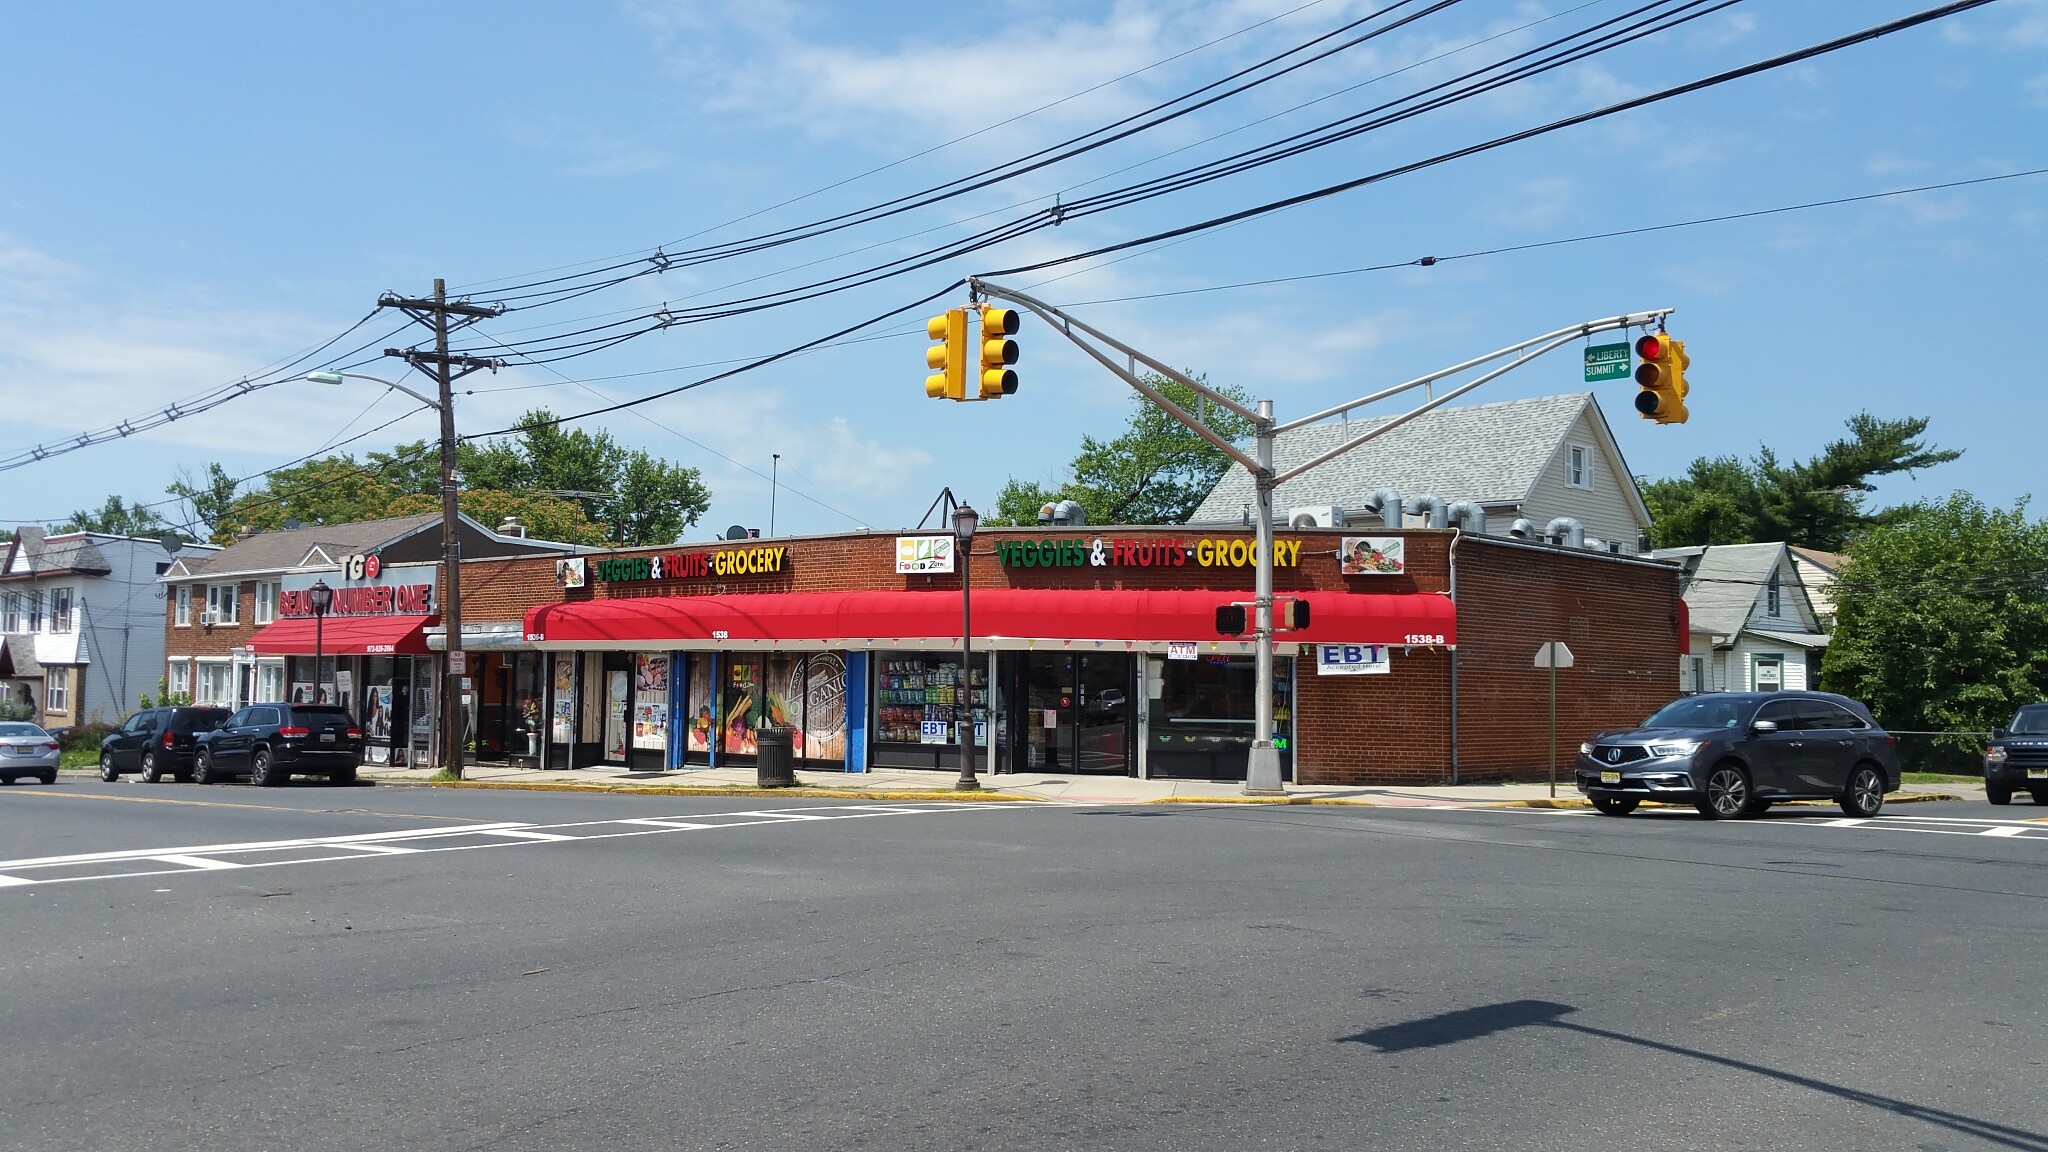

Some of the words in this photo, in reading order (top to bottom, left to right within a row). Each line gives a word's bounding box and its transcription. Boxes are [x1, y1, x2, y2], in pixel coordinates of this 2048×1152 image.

[1596, 348, 1628, 361] LIBERTY
[1586, 364, 1615, 376] SUMMIT
[996, 539, 1084, 568] VEGGIES
[1090, 538, 1106, 567] &
[1112, 539, 1186, 567] FRUITS
[1197, 539, 1302, 568] GROCRY
[598, 557, 649, 582] VEGGIES
[651, 556, 662, 579] &
[664, 553, 709, 578] FRUITS
[715, 547, 785, 576] GROCERY
[278, 590, 330, 615] BEAU
[333, 586, 393, 613] NUMBER
[397, 584, 428, 611] ONE
[712, 630, 728, 639] 1538
[1404, 634, 1445, 644] 1538-B
[1170, 645, 1196, 655] ATM
[1323, 644, 1384, 664] EBT
[922, 722, 946, 735] EBT
